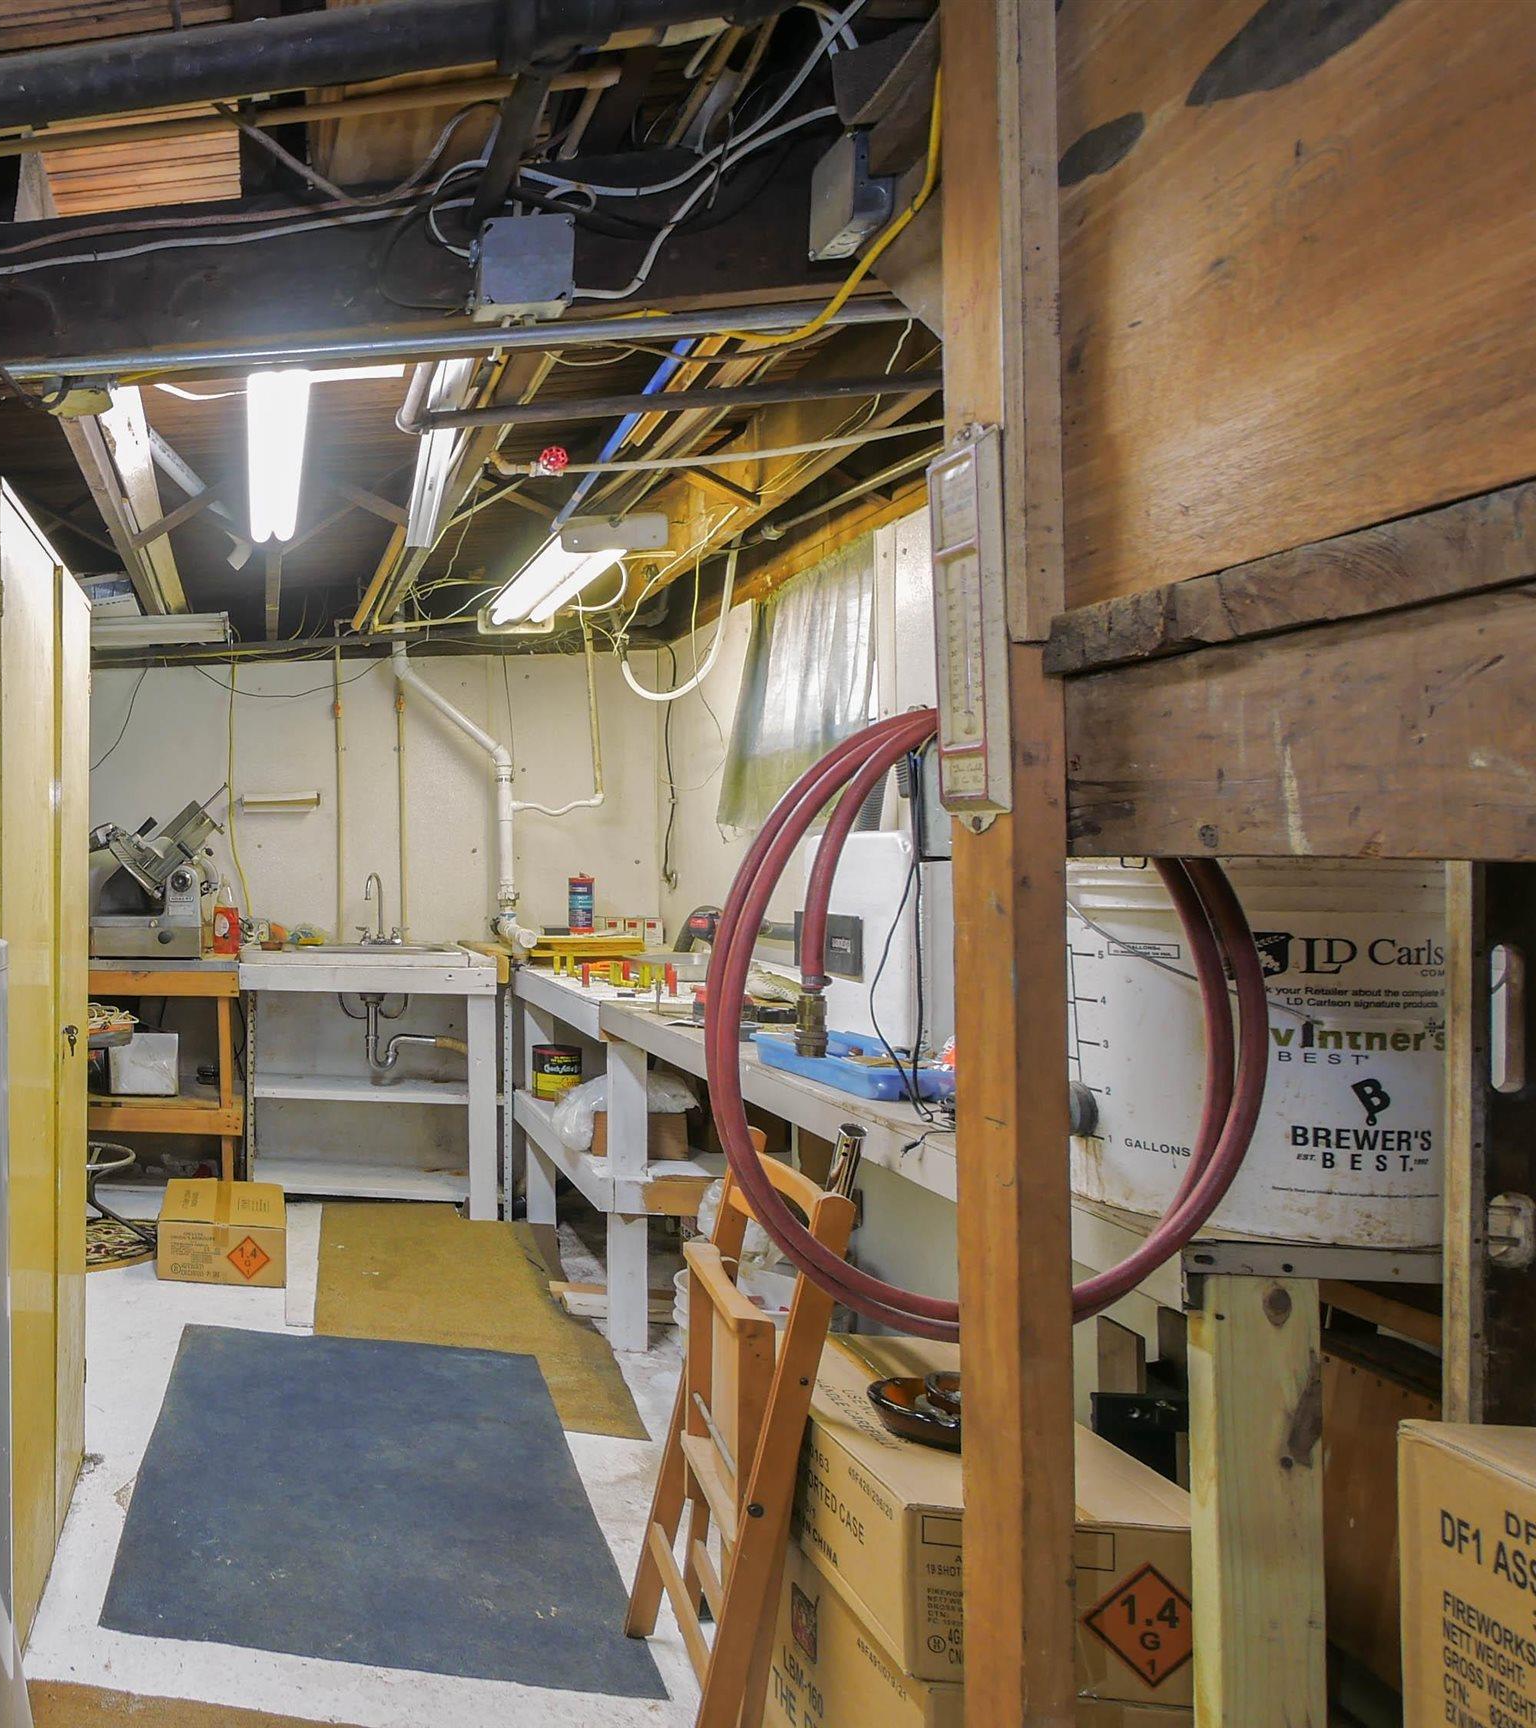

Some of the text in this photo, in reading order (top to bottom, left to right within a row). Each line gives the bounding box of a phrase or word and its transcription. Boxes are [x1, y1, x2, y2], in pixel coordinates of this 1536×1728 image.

[1097, 950, 1105, 960] 5
[1299, 937, 1444, 975] LD Carls
[1100, 996, 1107, 1005] 4
[1275, 987, 1301, 997] your
[1305, 986, 1349, 996] Retailer
[1352, 988, 1382, 997] about
[1385, 988, 1400, 997] the
[1286, 997, 1303, 1006] LD
[1307, 998, 1350, 1007] Carlson
[1354, 999, 1400, 1009] signature
[1102, 1040, 1109, 1049] 3
[1105, 1087, 1112, 1096] 2
[1124, 1138, 1191, 1157] GALLONS
[1290, 1125, 1432, 1151] BREWER'S
[237, 1246, 258, 1259] 1.4
[839, 1502, 866, 1546] CASE
[1440, 1509, 1483, 1565] DF1
[812, 1530, 840, 1568] CHINA
[1120, 1594, 1180, 1629] 1.4
[1443, 1589, 1536, 1667] FIREWORKS
[1139, 1632, 1161, 1651] G
[1442, 1617, 1527, 1689] NETT WEIGHT:
[1146, 1658, 1156, 1675] 1
[1442, 1646, 1484, 1691] GROSS
[772, 1665, 798, 1726] THE
[1442, 1672, 1471, 1710] CTN:
